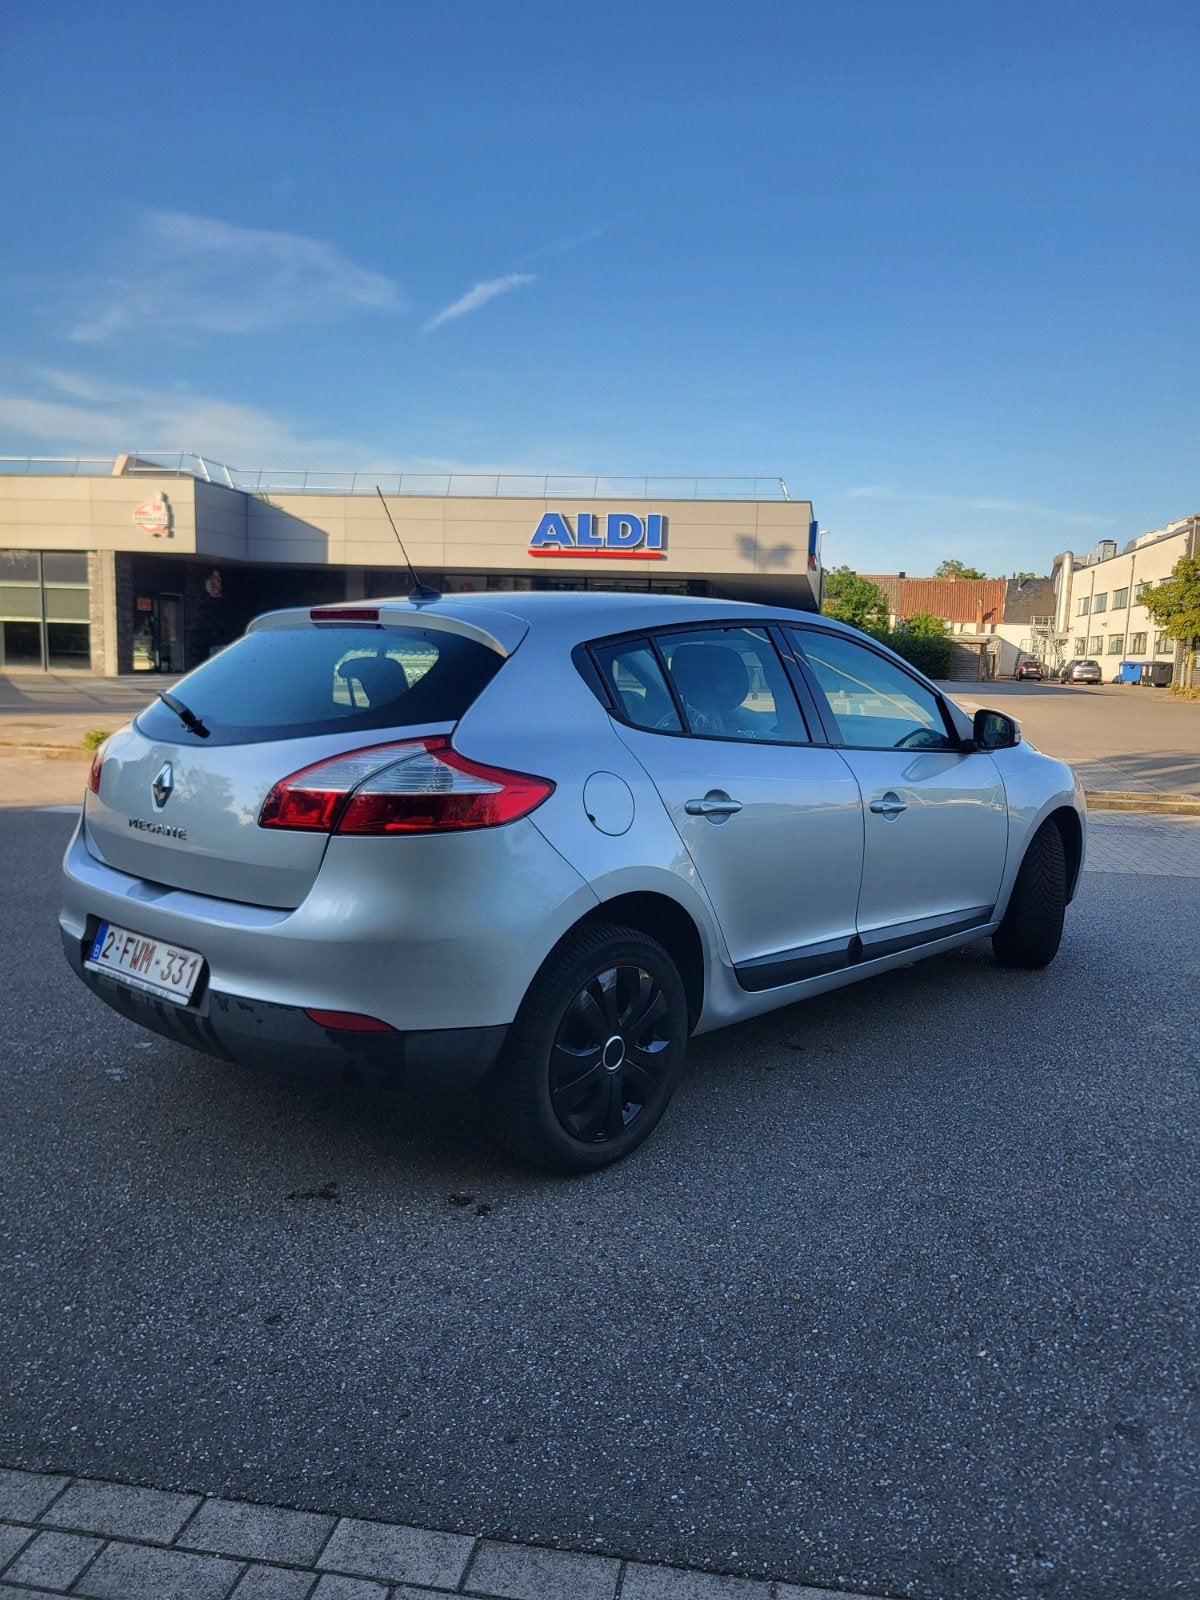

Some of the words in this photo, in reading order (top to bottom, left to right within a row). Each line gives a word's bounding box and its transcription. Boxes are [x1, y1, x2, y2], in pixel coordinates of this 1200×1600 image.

[529, 512, 662, 548] ALDI
[128, 818, 187, 840] MEGANE
[92, 944, 101, 958] B
